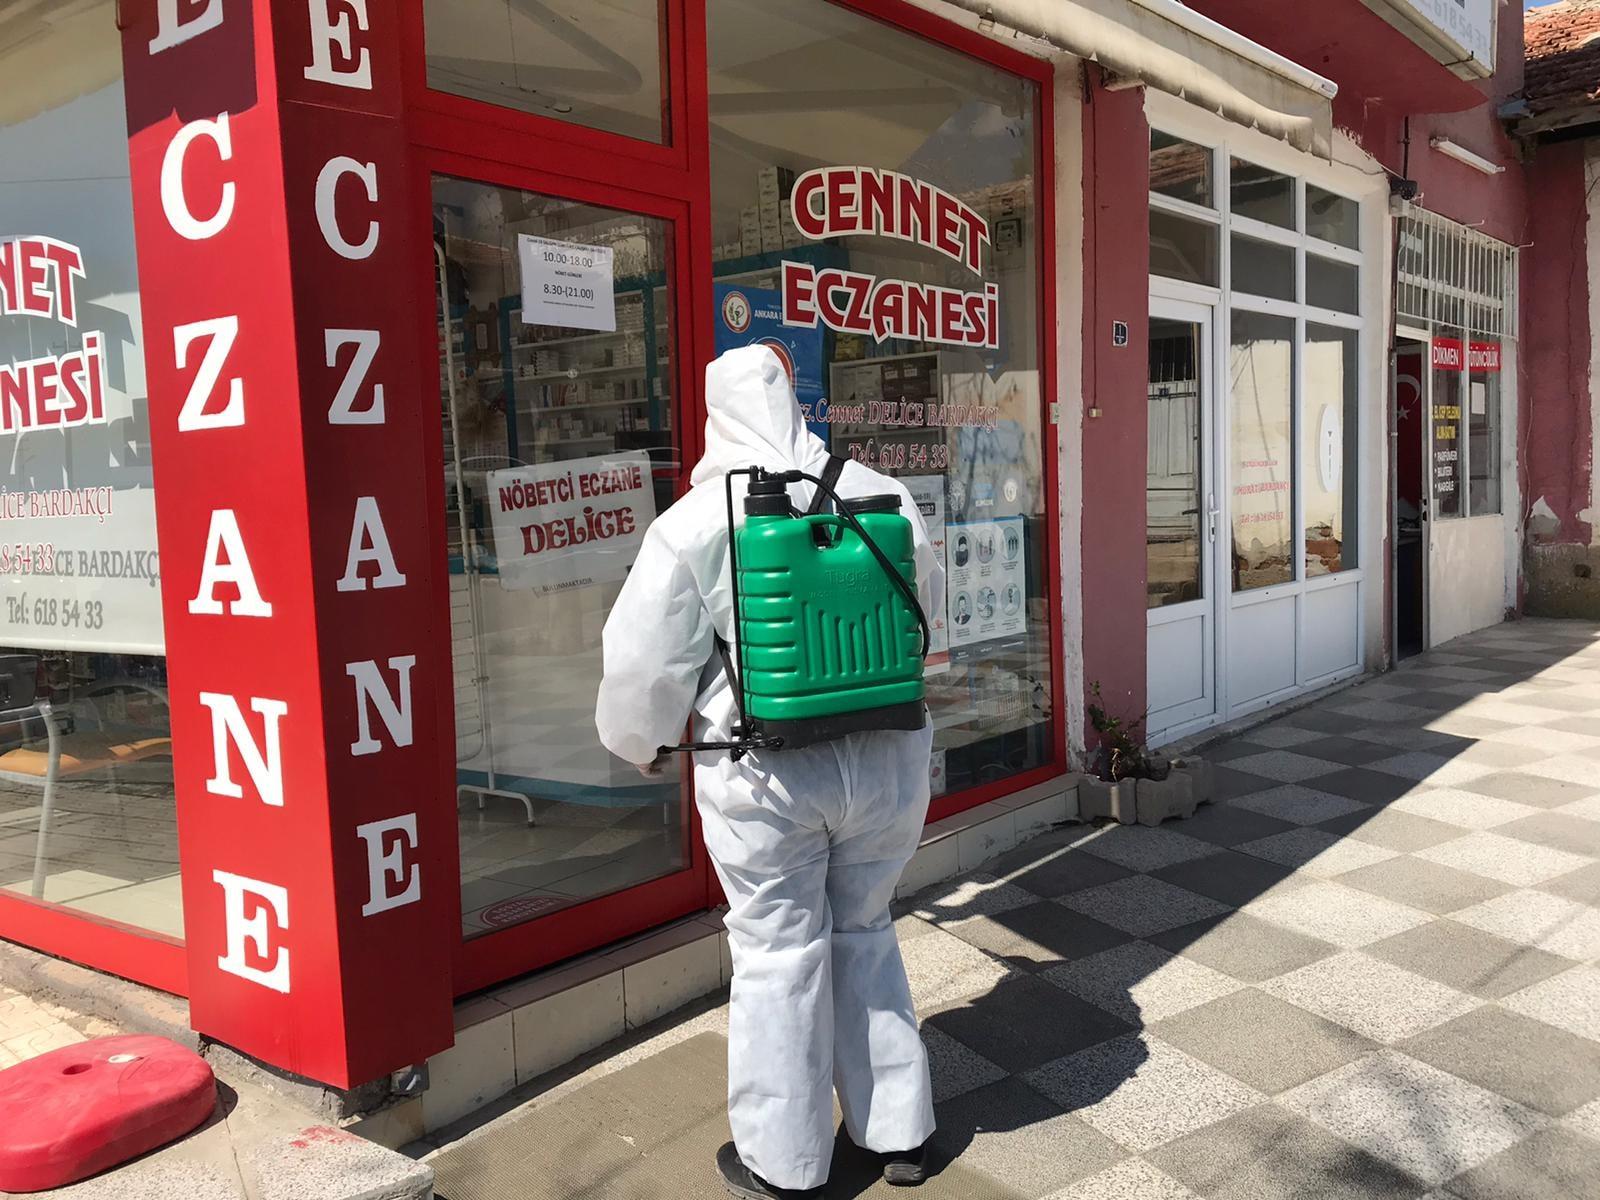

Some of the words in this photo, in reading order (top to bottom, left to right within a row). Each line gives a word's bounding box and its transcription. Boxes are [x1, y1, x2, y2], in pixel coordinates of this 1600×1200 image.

[790, 166, 991, 277] CENNET
[543, 251, 593, 268] 10.00-18.00
[543, 283, 594, 301] 8.30-(21.00)
[781, 259, 999, 349] ECZANESİ
[754, 310, 779, 320] ANKARA
[1433, 342, 1459, 366] DİKMEN
[867, 396, 924, 426] DELİCE
[927, 403, 1000, 433] BARDAKÇI
[880, 442, 906, 469] 618
[908, 443, 927, 469] 54
[930, 443, 948, 469] 33
[0, 485, 26, 520] İCE
[28, 487, 114, 525] BARDAKÇI
[499, 472, 575, 512] NÖBETCİ
[578, 466, 642, 498] ECZANE
[519, 506, 636, 556] DELİCE
[14, 542, 32, 572] 54
[36, 541, 54, 572] 33
